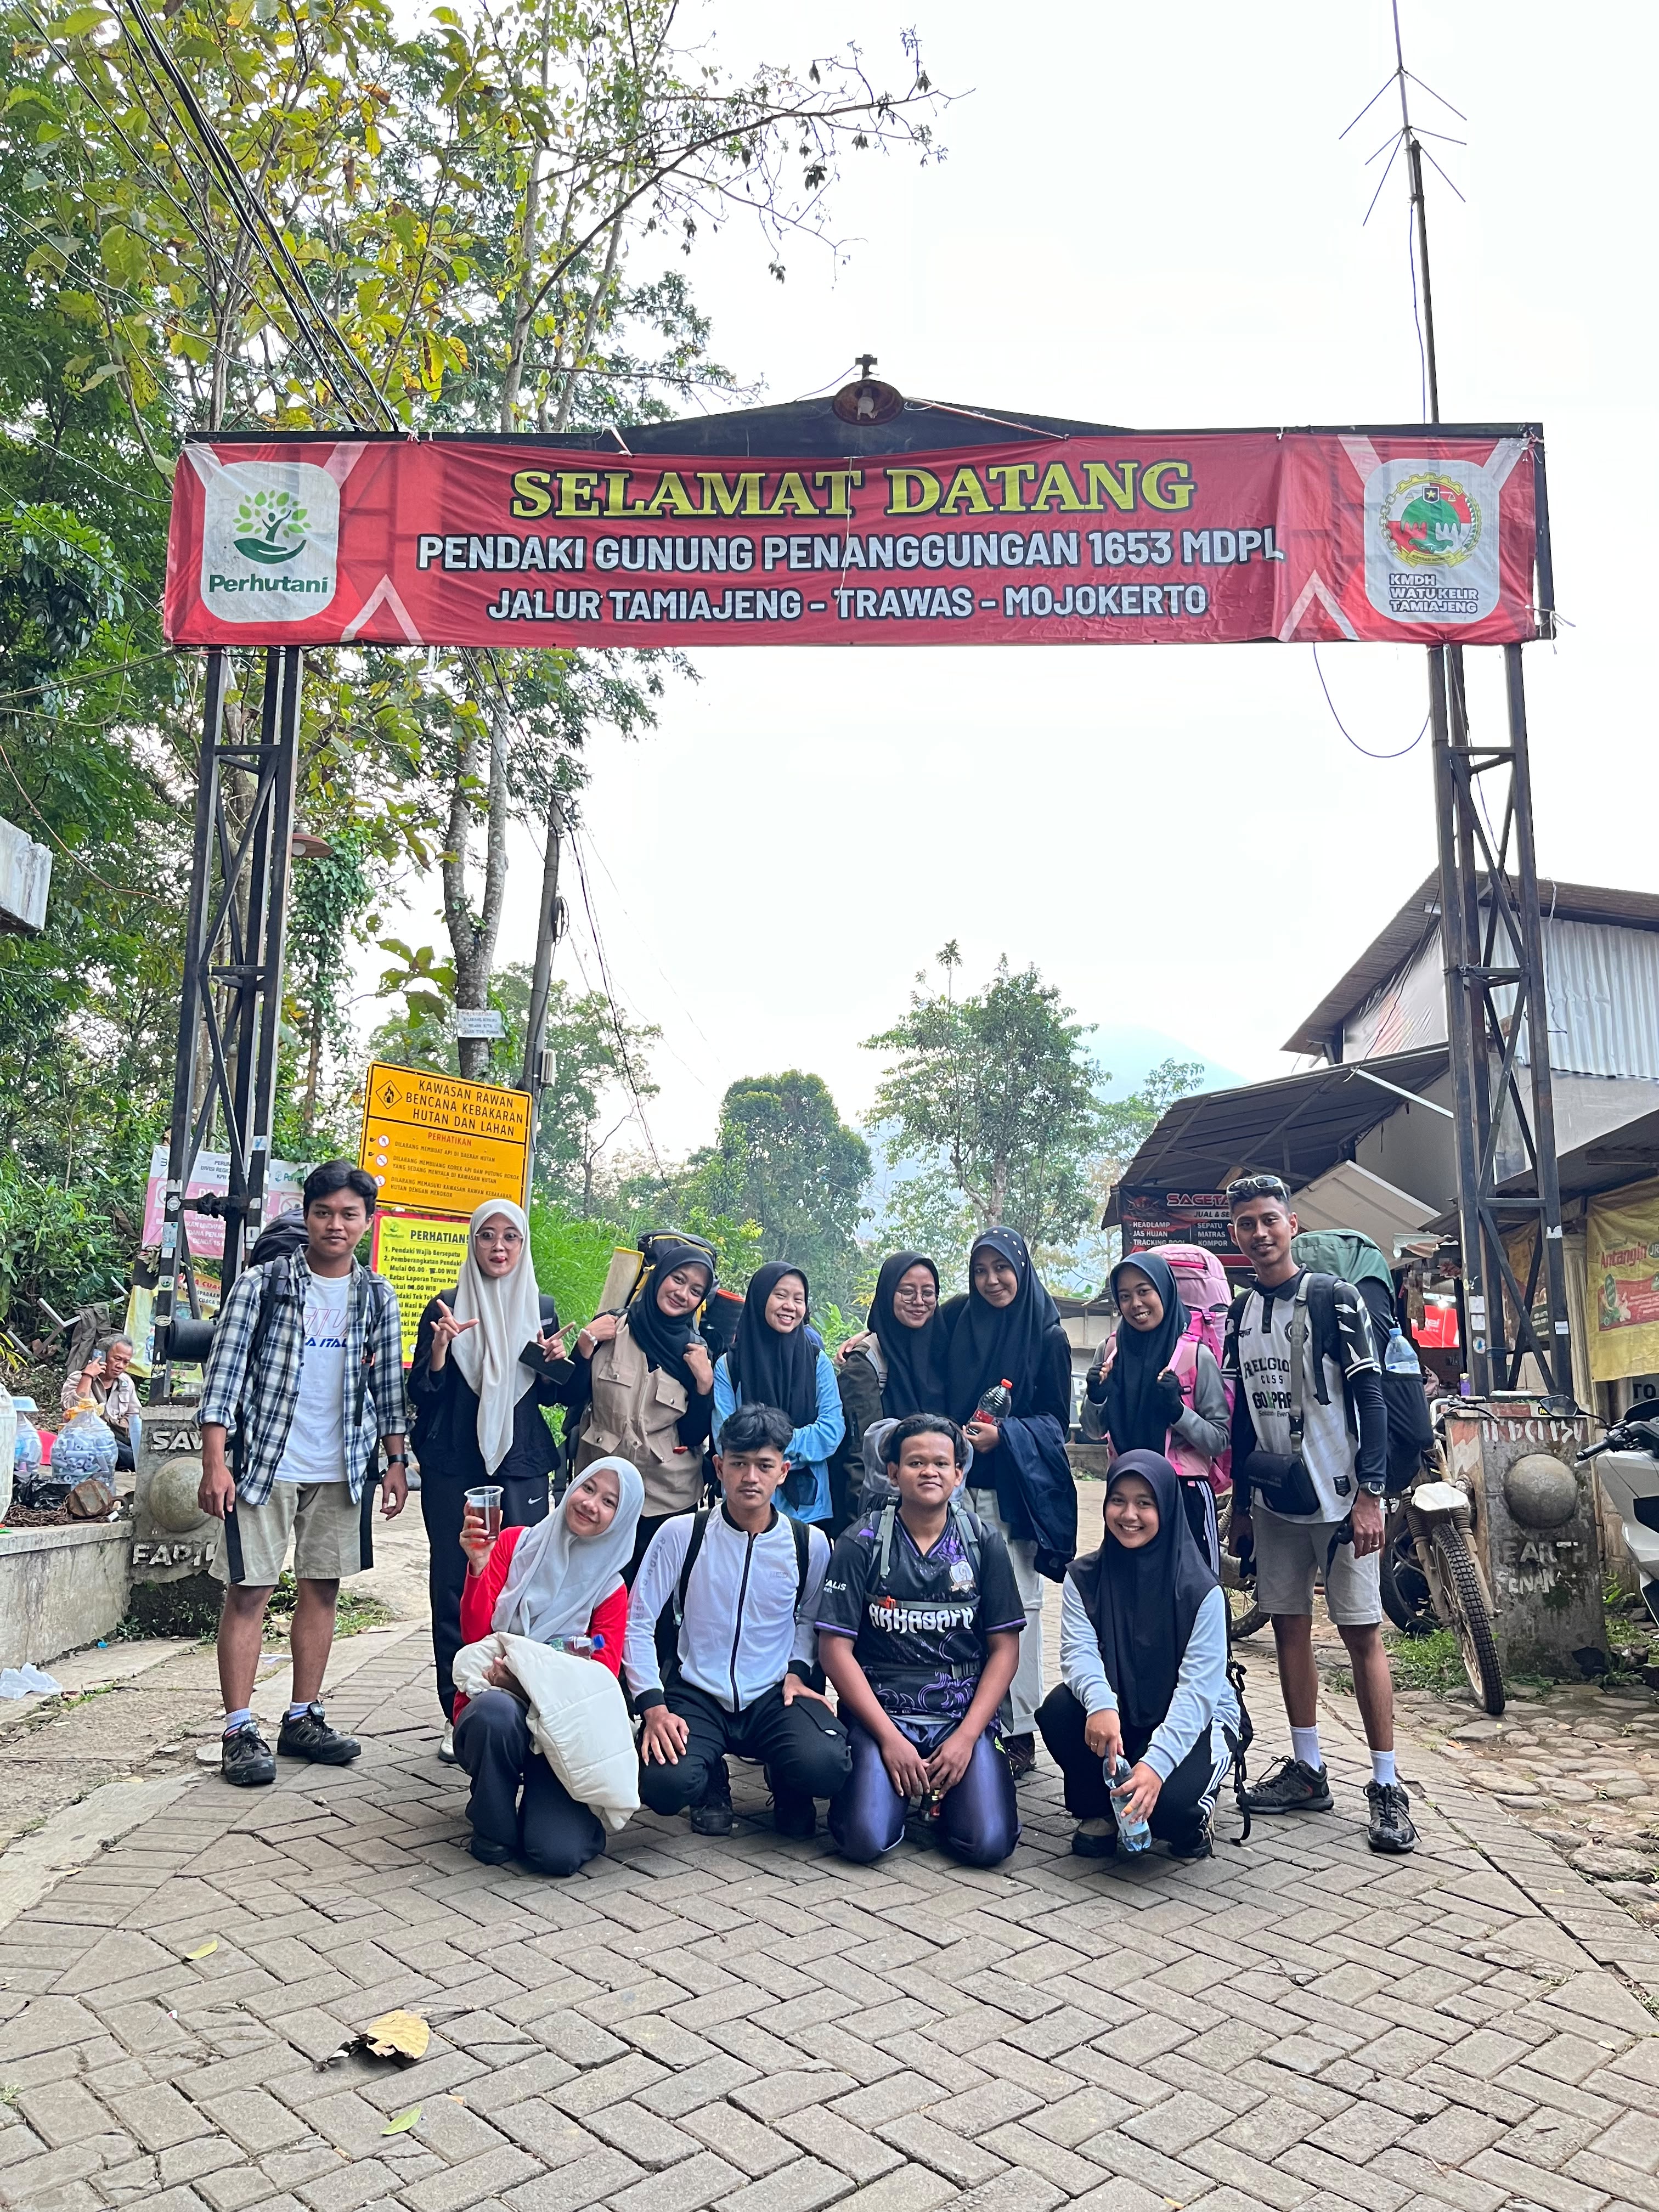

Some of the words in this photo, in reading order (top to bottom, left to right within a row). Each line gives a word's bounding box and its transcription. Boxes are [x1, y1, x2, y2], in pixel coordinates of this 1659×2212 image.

[511, 470, 862, 517] SELAMAT
[884, 462, 1194, 514] DATANG
[419, 535, 584, 571] PENDAKI
[596, 537, 753, 571] GUNUNG
[764, 532, 1077, 571] PENANGGUNGAN
[1087, 531, 1172, 566] 1653
[1183, 528, 1285, 565] MDPL
[208, 573, 328, 594] Perhutani
[1389, 574, 1436, 585] KMDH
[489, 590, 601, 620] JALUR
[609, 590, 801, 620] TAMIAJENG
[833, 589, 973, 619] TRAWAS
[1006, 585, 1207, 616] MOJOKERTO
[1391, 601, 1478, 613] TAMIAJENG
[419, 1080, 471, 1100] KAWASAN
[476, 1092, 514, 1108] RAWAN
[406, 1092, 456, 1111] BENCANA
[462, 1103, 523, 1124] KEBAKARAN
[413, 1108, 448, 1125] HUTAN
[454, 1116, 475, 1129] DAN
[481, 1121, 515, 1136] LAHAN
[394, 1141, 419, 1150] DILARANG
[428, 1132, 472, 1146] PERHATIKAN
[393, 1155, 417, 1164] DILARANG
[407, 1165, 426, 1173] SEDANG
[391, 1176, 415, 1185] DILARANG
[391, 1256, 439, 1265] Pemberangkatan
[150, 1430, 203, 1450] SAV
